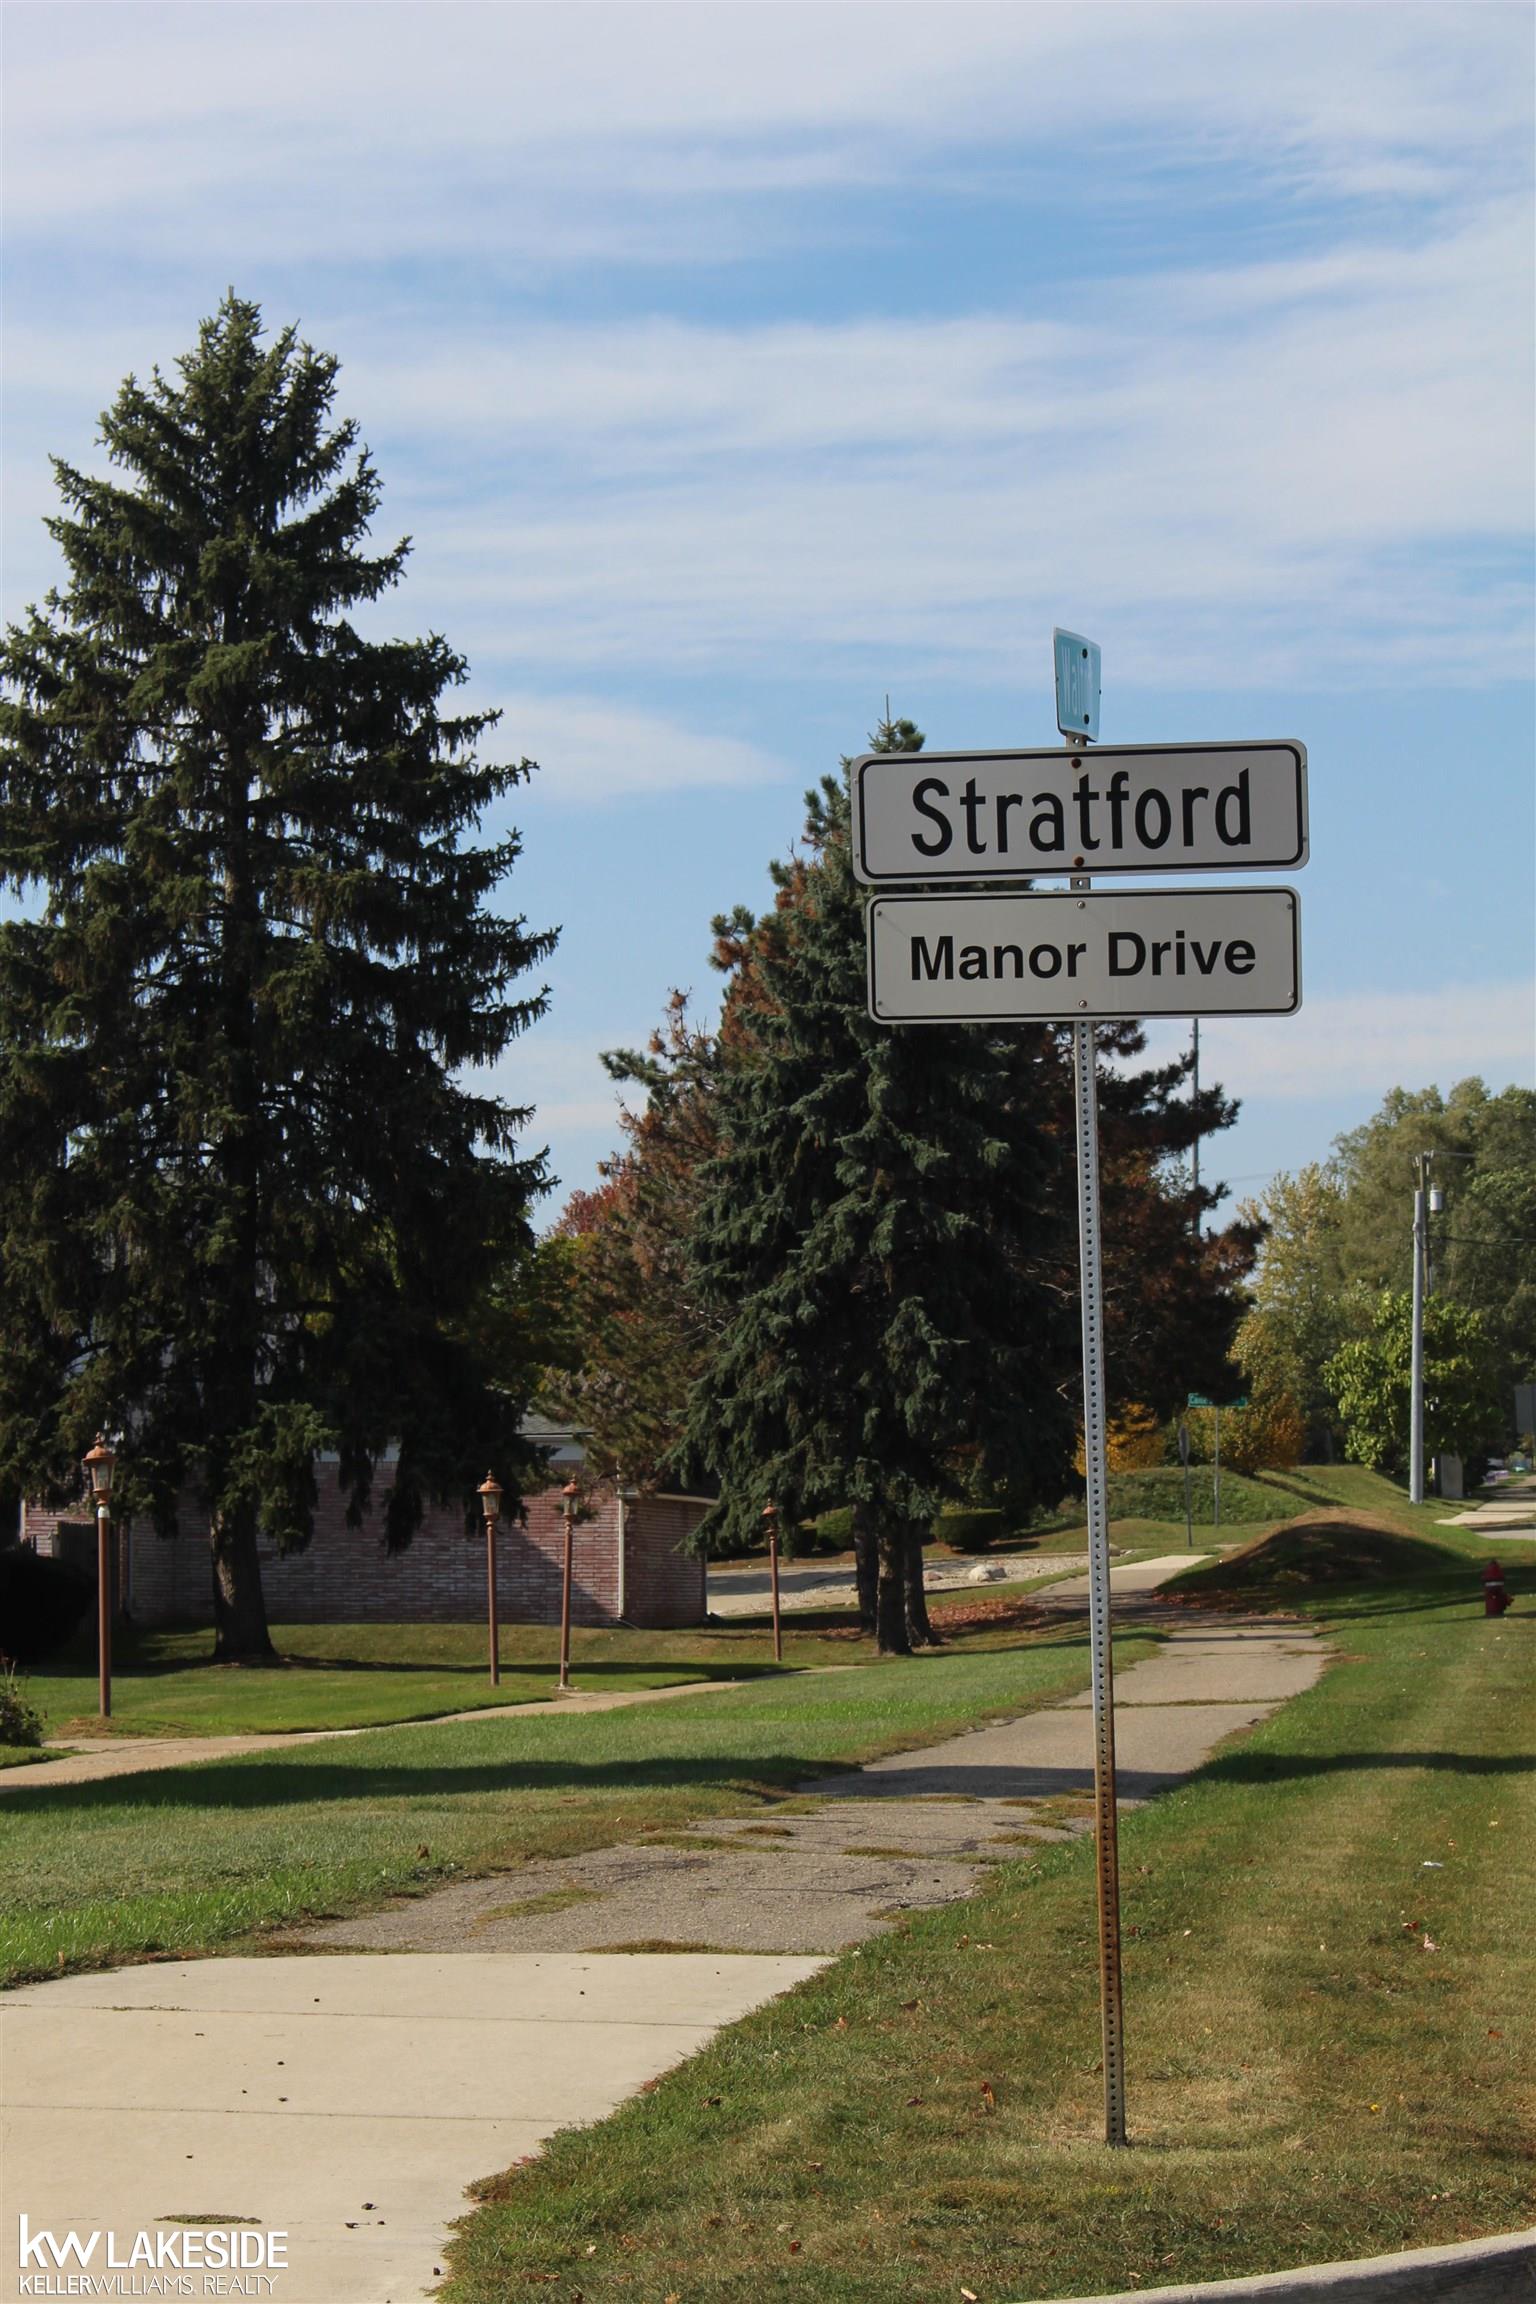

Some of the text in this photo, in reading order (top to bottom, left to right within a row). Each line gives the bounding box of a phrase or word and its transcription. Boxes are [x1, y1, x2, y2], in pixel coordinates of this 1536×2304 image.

[910, 767, 1252, 857] Stratford
[910, 930, 1256, 981] Manor Drive
